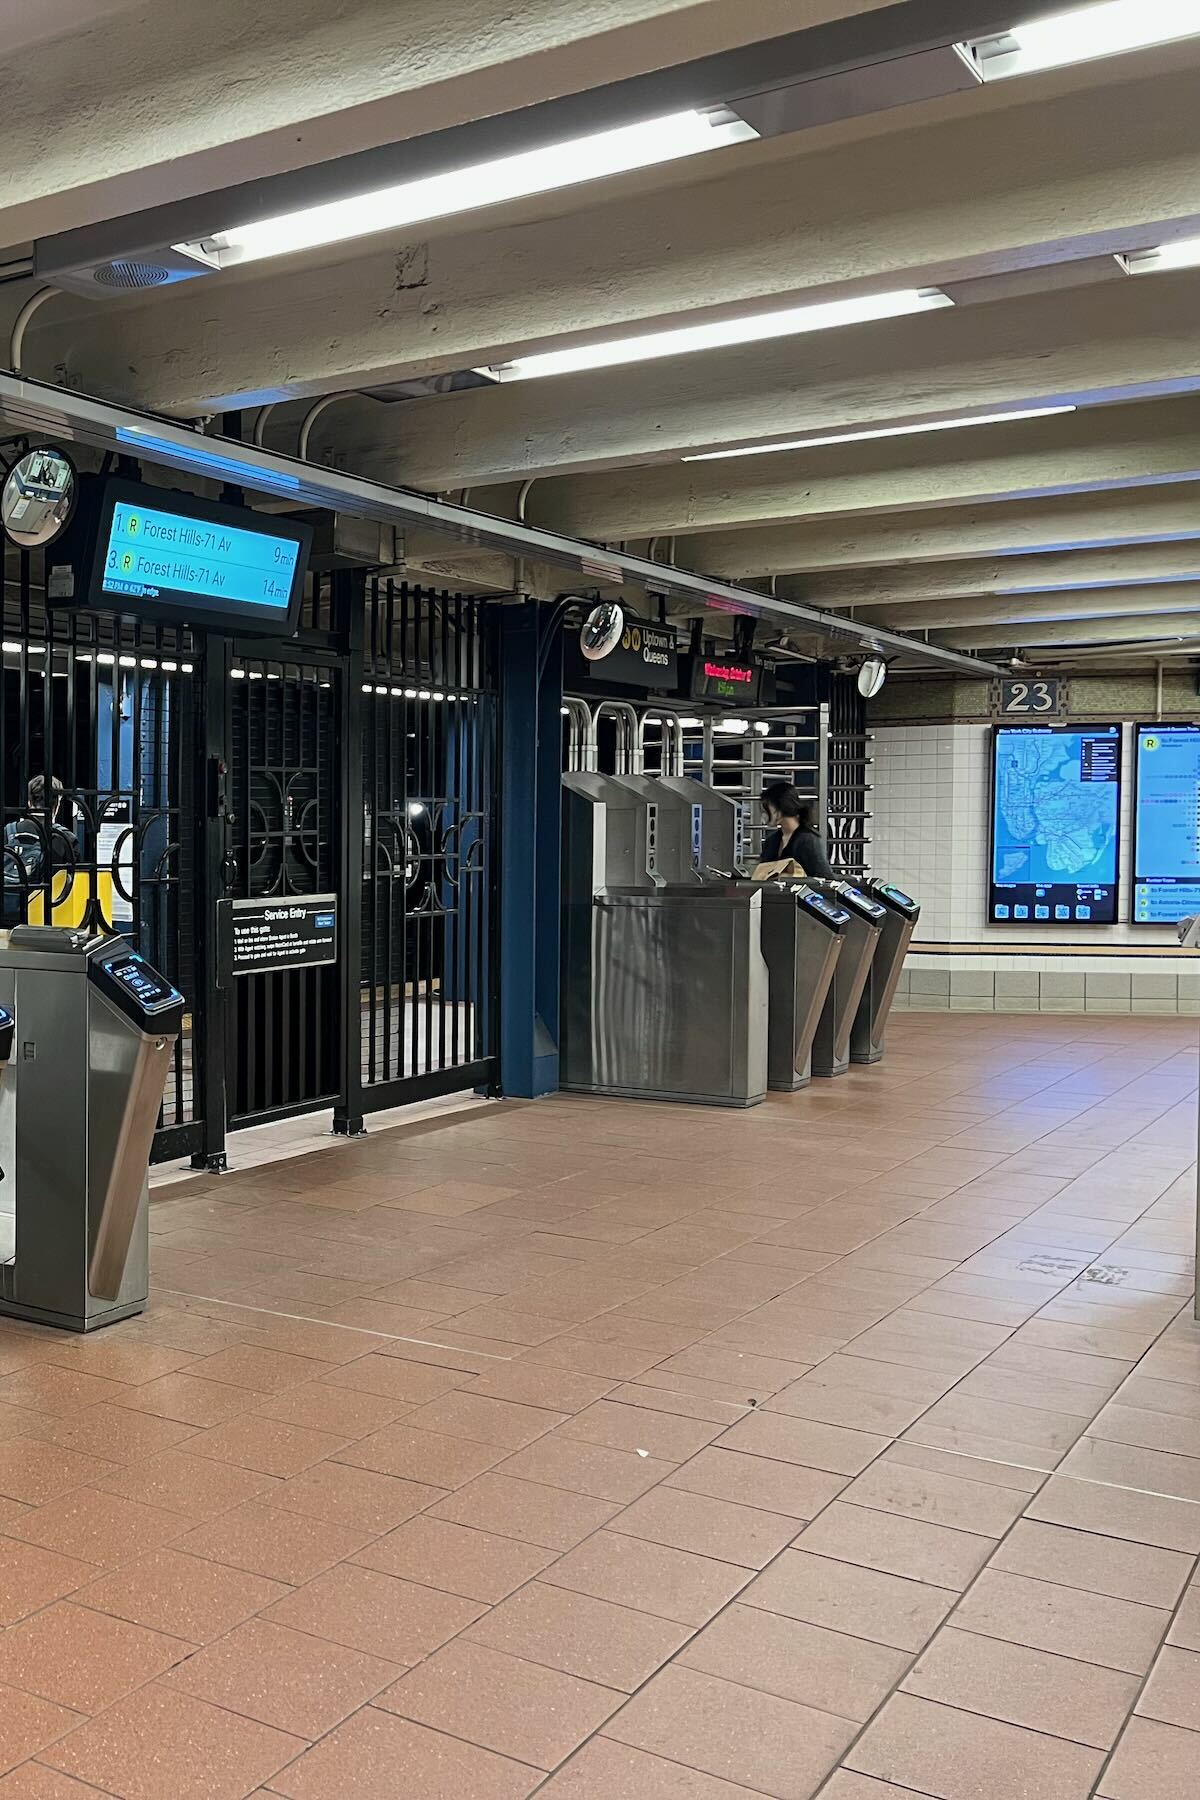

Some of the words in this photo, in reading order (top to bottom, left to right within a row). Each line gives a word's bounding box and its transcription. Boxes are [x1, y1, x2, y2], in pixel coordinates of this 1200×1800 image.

[116, 513, 125, 533] 1.
[143, 520, 178, 542] Forest
[179, 527, 216, 550] Hills-71
[218, 536, 232, 552] Av
[108, 550, 119, 569] 3.
[137, 556, 171, 578] Forest
[173, 563, 210, 587] Hills-71
[212, 571, 226, 587] Av
[642, 629, 668, 648] Uptown
[642, 646, 669, 666] Queens
[1006, 682, 1053, 711] 23
[264, 908, 289, 921] Service
[289, 907, 307, 920] Entry
